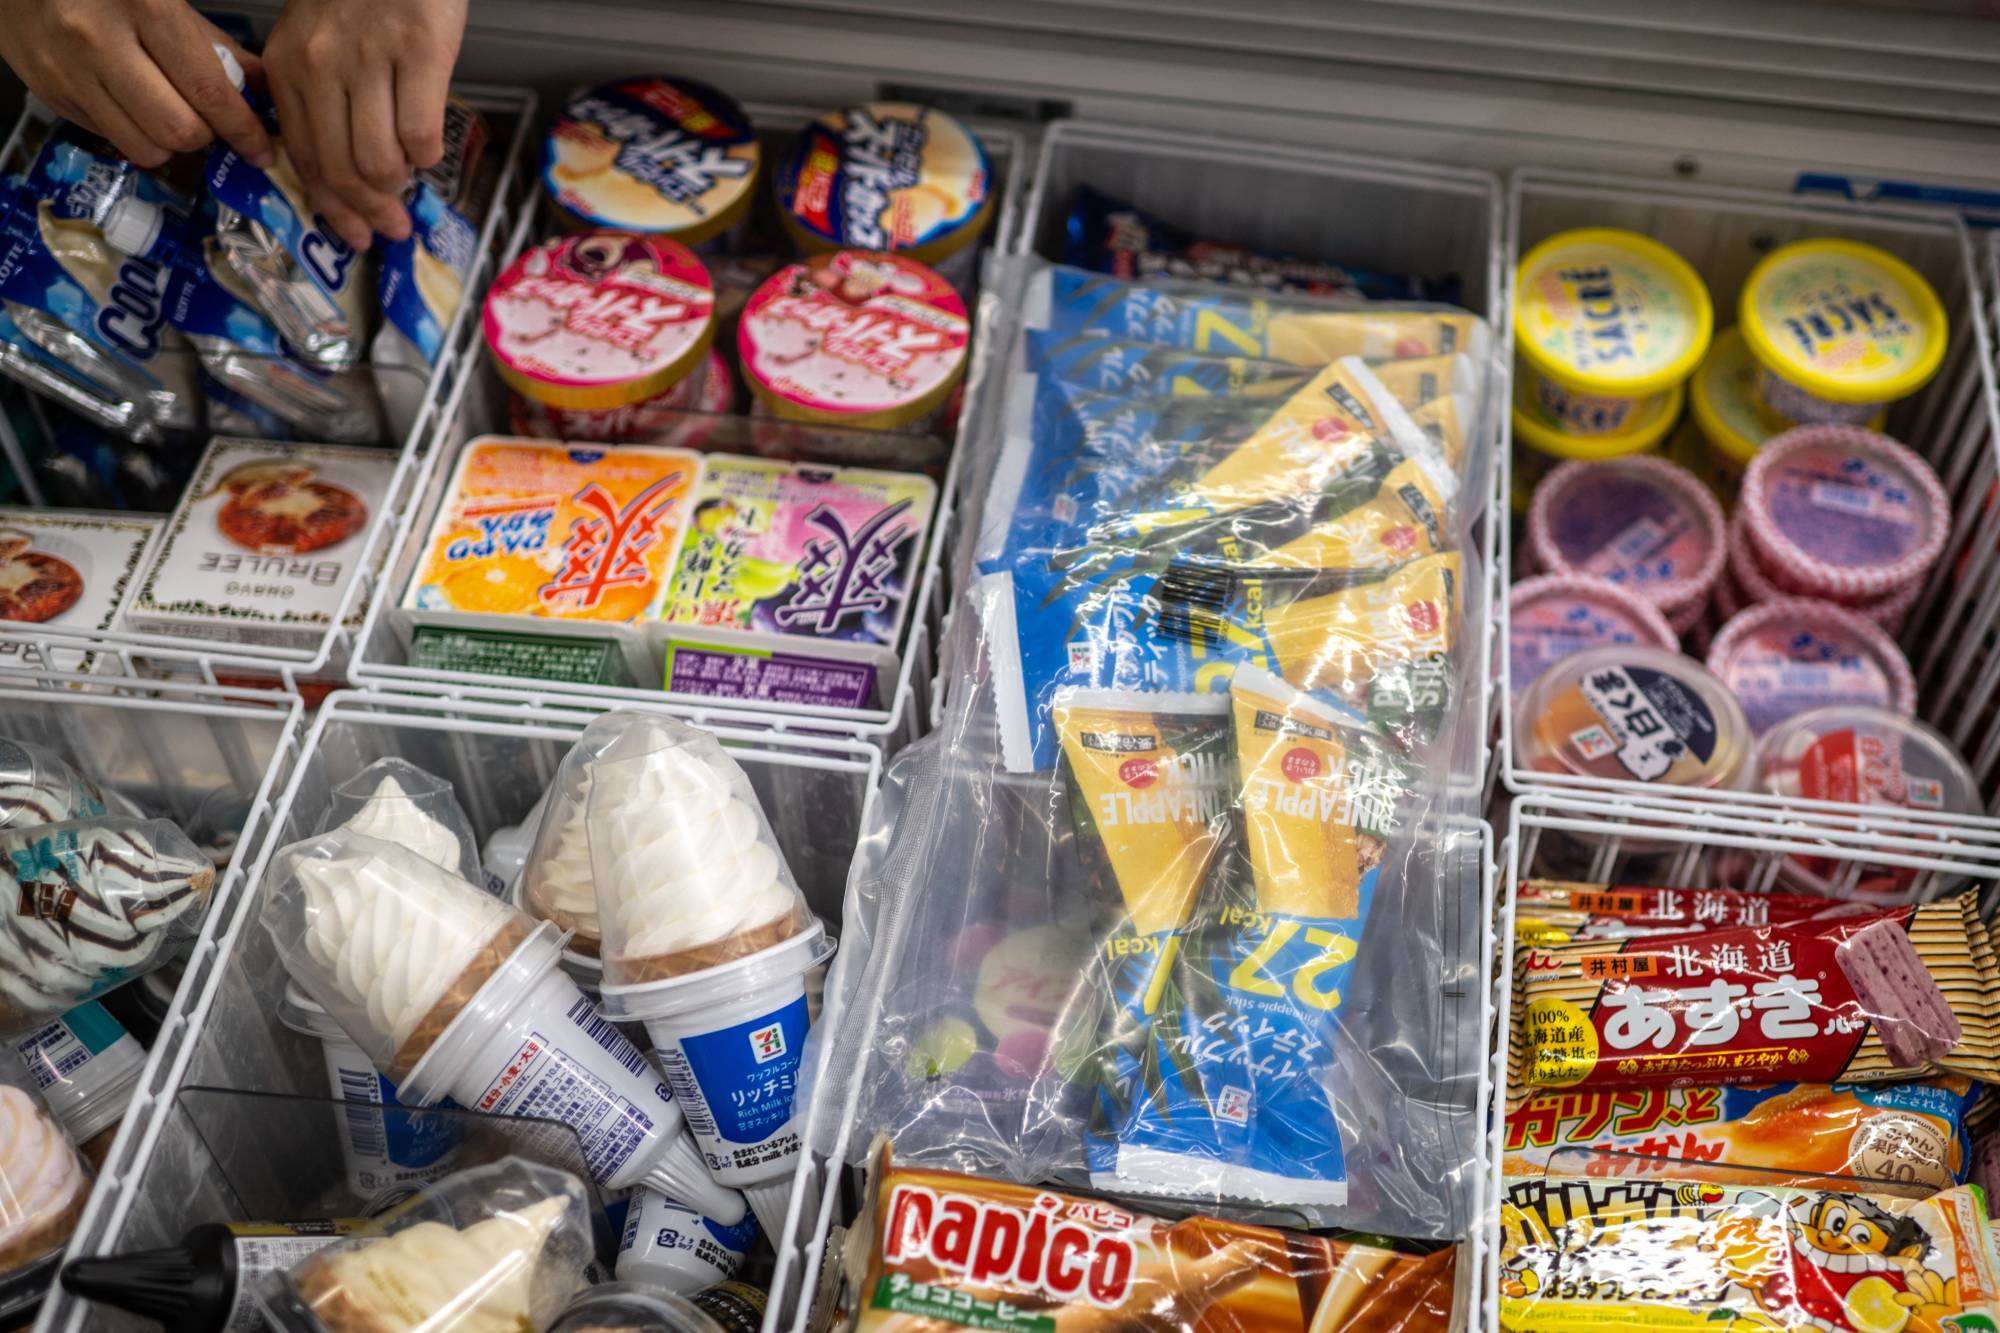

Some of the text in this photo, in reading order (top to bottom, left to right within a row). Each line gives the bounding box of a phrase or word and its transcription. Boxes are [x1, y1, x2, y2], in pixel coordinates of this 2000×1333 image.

[212, 149, 240, 190] LOTTE
[477, 510, 557, 535] みかん
[538, 472, 683, 608] 爽
[198, 551, 342, 587] BRULEE
[775, 497, 913, 632] 爽
[1242, 578, 1264, 630] kcal
[1219, 903, 1287, 934] kcal
[1655, 892, 1770, 926] 北海道
[1106, 936, 1162, 961] kcal
[1230, 919, 1358, 1010] 27
[1588, 941, 1796, 978] 井村屋 北海道
[1531, 1009, 1571, 1027] 100%
[1600, 976, 1823, 1050] あずき
[747, 1056, 799, 1084] ワッフルコーン
[736, 1105, 761, 1121] Rich
[761, 1097, 783, 1114] Milk
[1586, 1132, 1724, 1176] みかん
[1884, 1127, 1935, 1152] みかん
[1069, 1203, 1134, 1231] パピコ
[886, 1187, 1136, 1305] papico
[888, 1277, 1041, 1324] チョココーヒー
